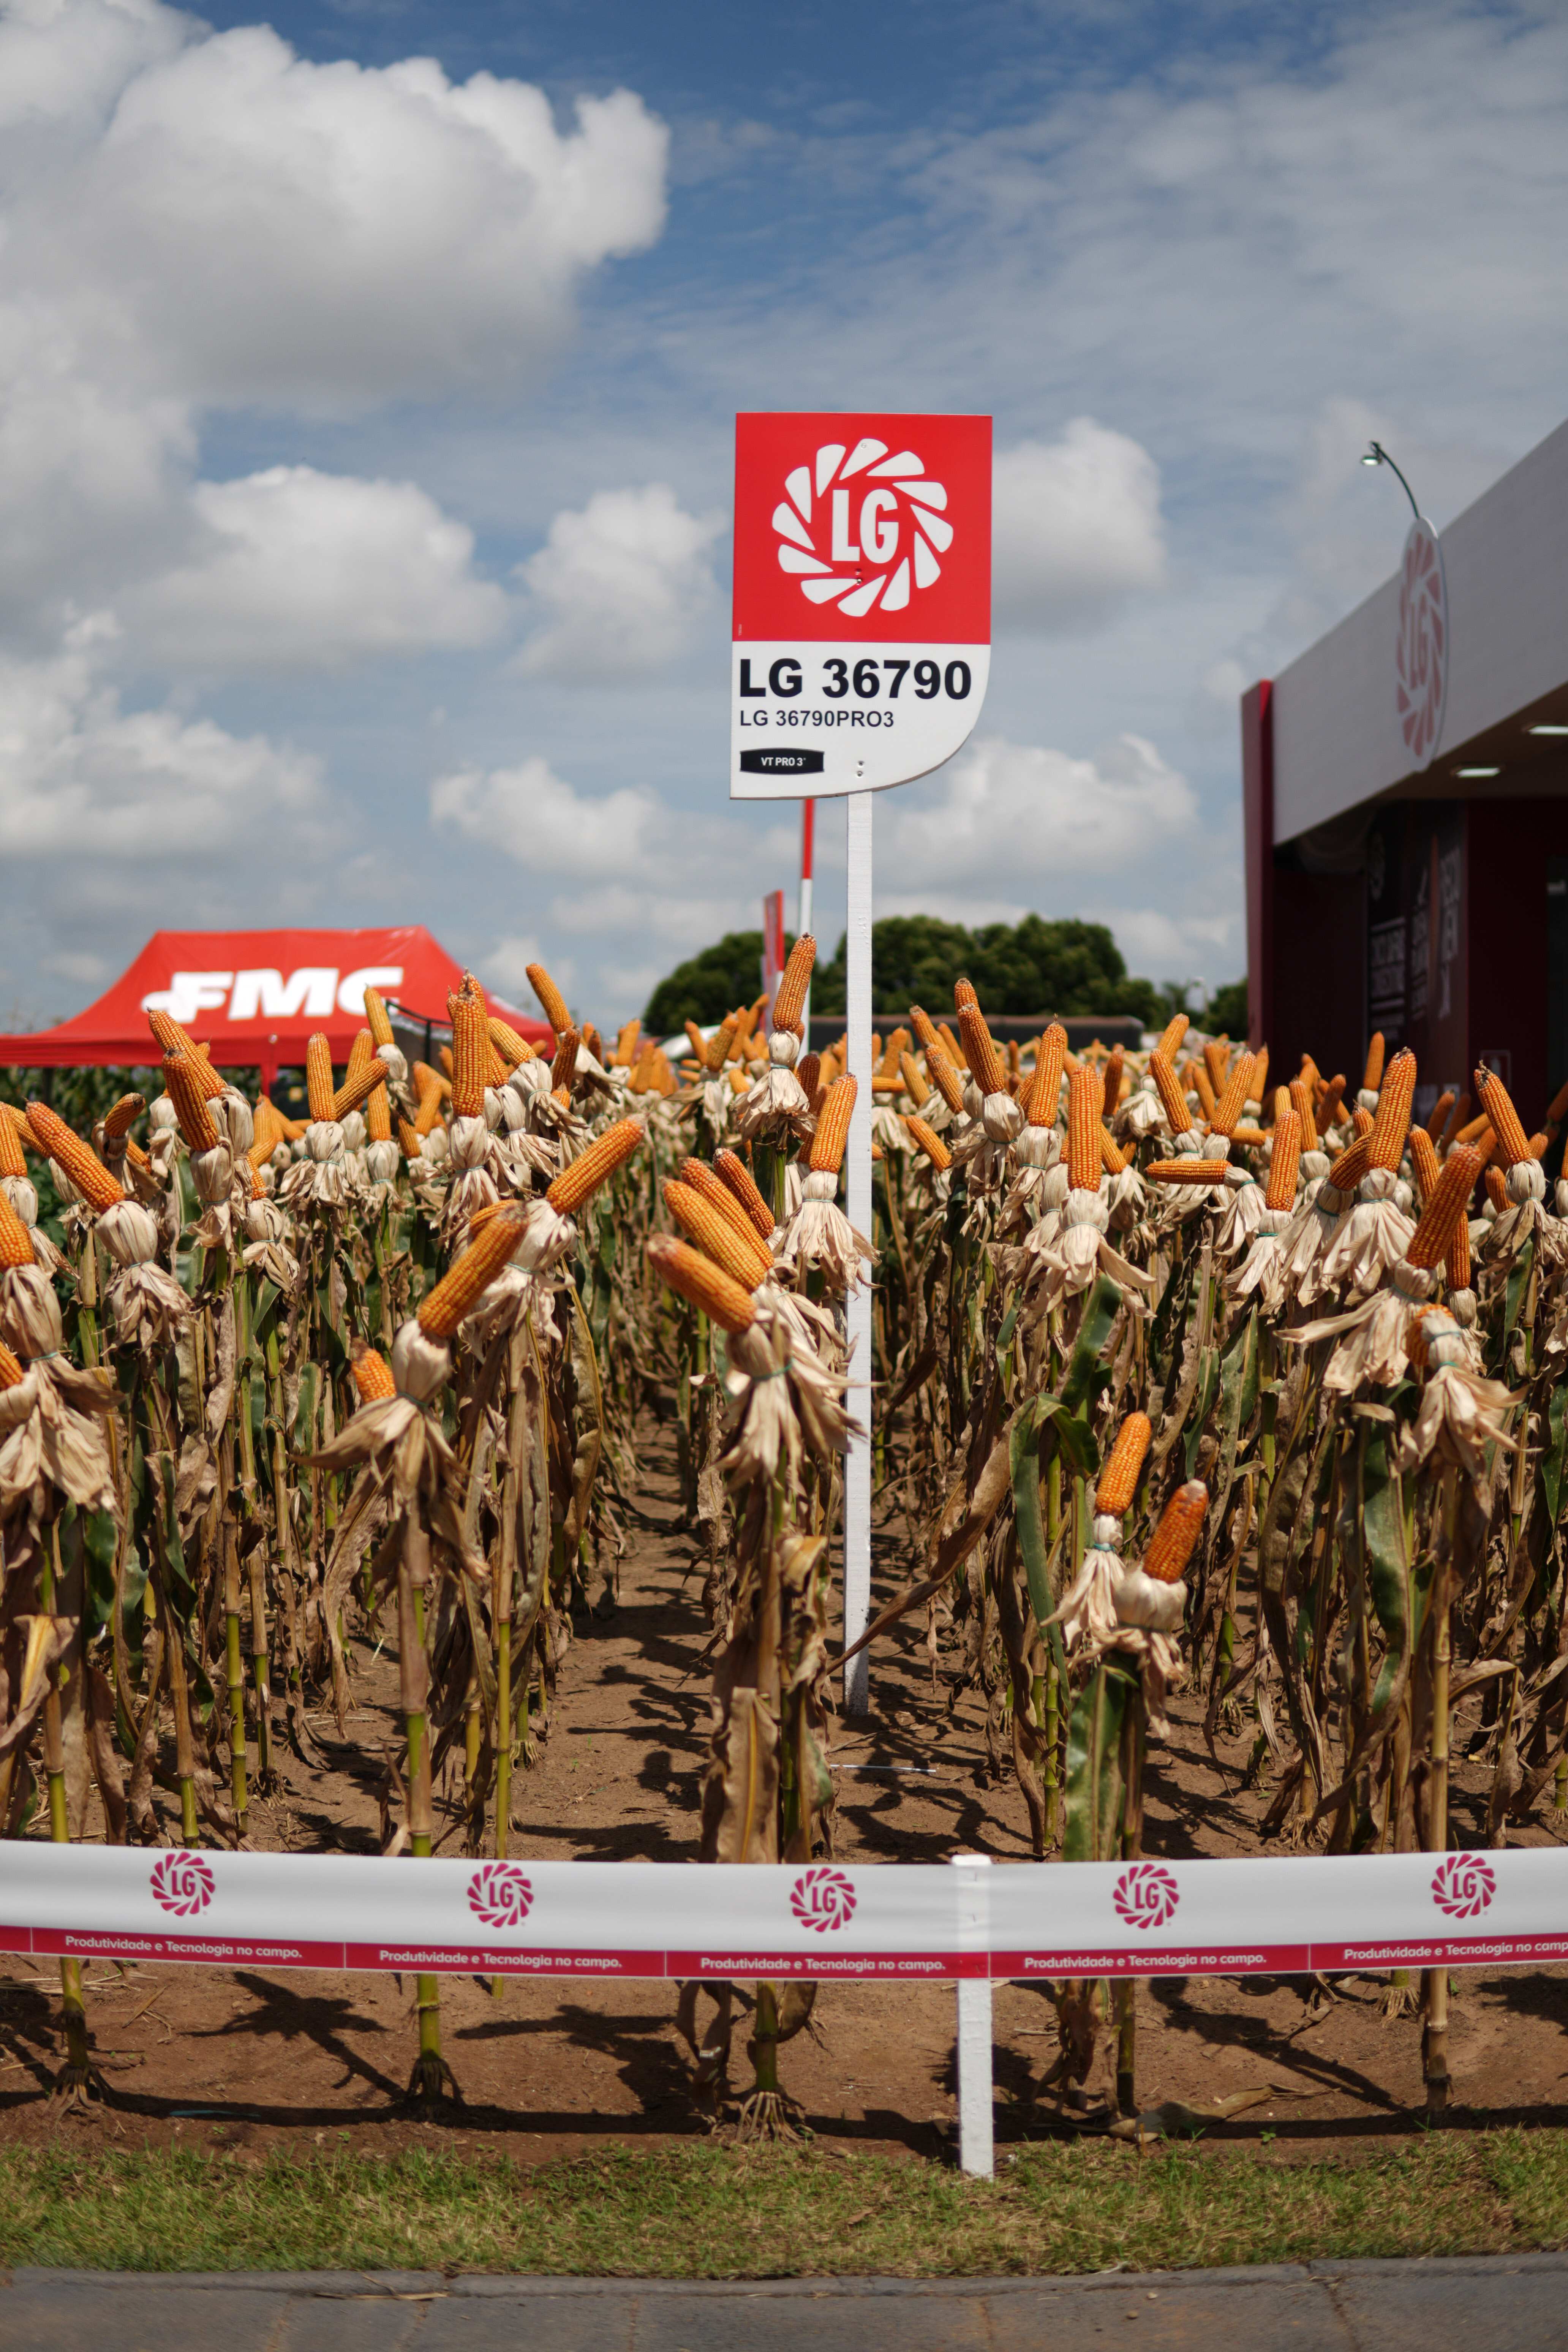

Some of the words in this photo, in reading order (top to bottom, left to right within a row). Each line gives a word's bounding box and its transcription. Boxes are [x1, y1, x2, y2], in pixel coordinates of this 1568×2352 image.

[831, 489, 899, 564] LG
[740, 658, 802, 698] LG
[822, 658, 971, 700] 36790
[740, 710, 768, 726] LG
[776, 710, 894, 727] 36790PRO3
[761, 757, 774, 766] VT
[775, 757, 795, 766] PRO
[141, 966, 403, 1024] FMC
[171, 1870, 196, 1897] LG
[489, 1881, 514, 1908] LG
[1135, 1882, 1160, 1909] LG
[1452, 1872, 1477, 1899] LG
[812, 1886, 836, 1913] LG
[65, 1935, 152, 1951] Produtividade
[154, 1943, 163, 1951] e
[165, 1941, 234, 1957] Tecnologia
[236, 1947, 253, 1956] no
[255, 1947, 302, 1960] campo.
[379, 1950, 469, 1964] Produtividade
[471, 1955, 480, 1964] e
[482, 1953, 552, 1968] Tecnologia
[555, 1957, 572, 1966] no
[574, 1958, 622, 1969] campo.
[1344, 1946, 1432, 1960] Produtividade
[1434, 1947, 1443, 1956] e
[1445, 1942, 1513, 1956] Tecnologia
[1516, 1943, 1532, 1952] no
[701, 1957, 791, 1970] Produtividade
[793, 1961, 803, 1969] e
[805, 1958, 876, 1973] Tecnologia
[878, 1961, 896, 1970] no
[898, 1961, 946, 1973] campo.
[1024, 1956, 1114, 1969] Produtividade
[1116, 1958, 1125, 1967] e
[1128, 1954, 1198, 1968] Tecnologia
[1200, 1956, 1217, 1965] no
[1219, 1954, 1267, 1966] campo.
